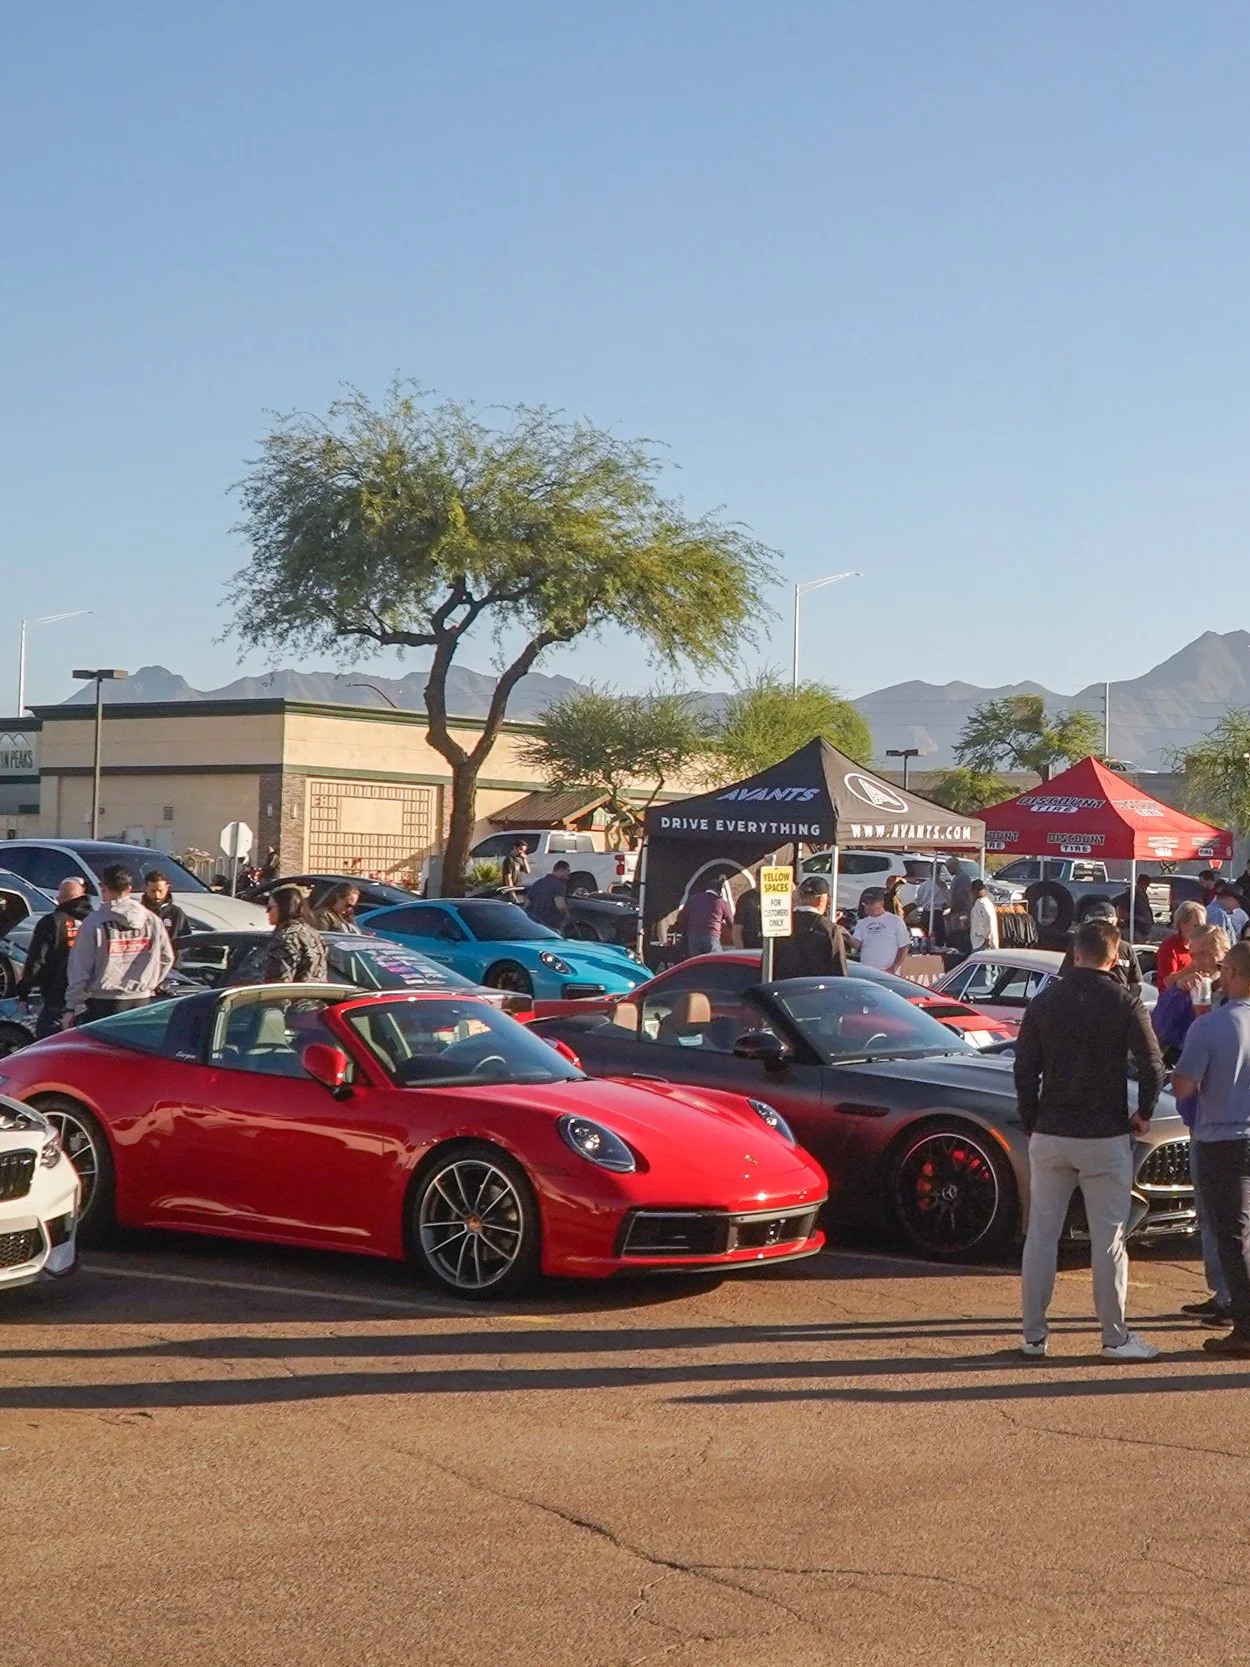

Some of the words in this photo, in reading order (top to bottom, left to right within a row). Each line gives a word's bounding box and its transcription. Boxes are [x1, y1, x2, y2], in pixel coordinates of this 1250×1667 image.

[11, 750, 33, 769] PEAKS
[717, 787, 820, 802] AVANTS
[1016, 796, 1106, 809] DISCOUNT
[1033, 805, 1076, 813] TIRE
[661, 817, 708, 830] DRIVE
[716, 819, 821, 836] EVERYTHING
[850, 824, 971, 840] WWW.AVANTS.COM
[1047, 832, 1105, 845] DISCOUNT
[763, 873, 790, 881] YELLOW
[764, 884, 788, 892] SPACES
[769, 919, 783, 927] ONLY
